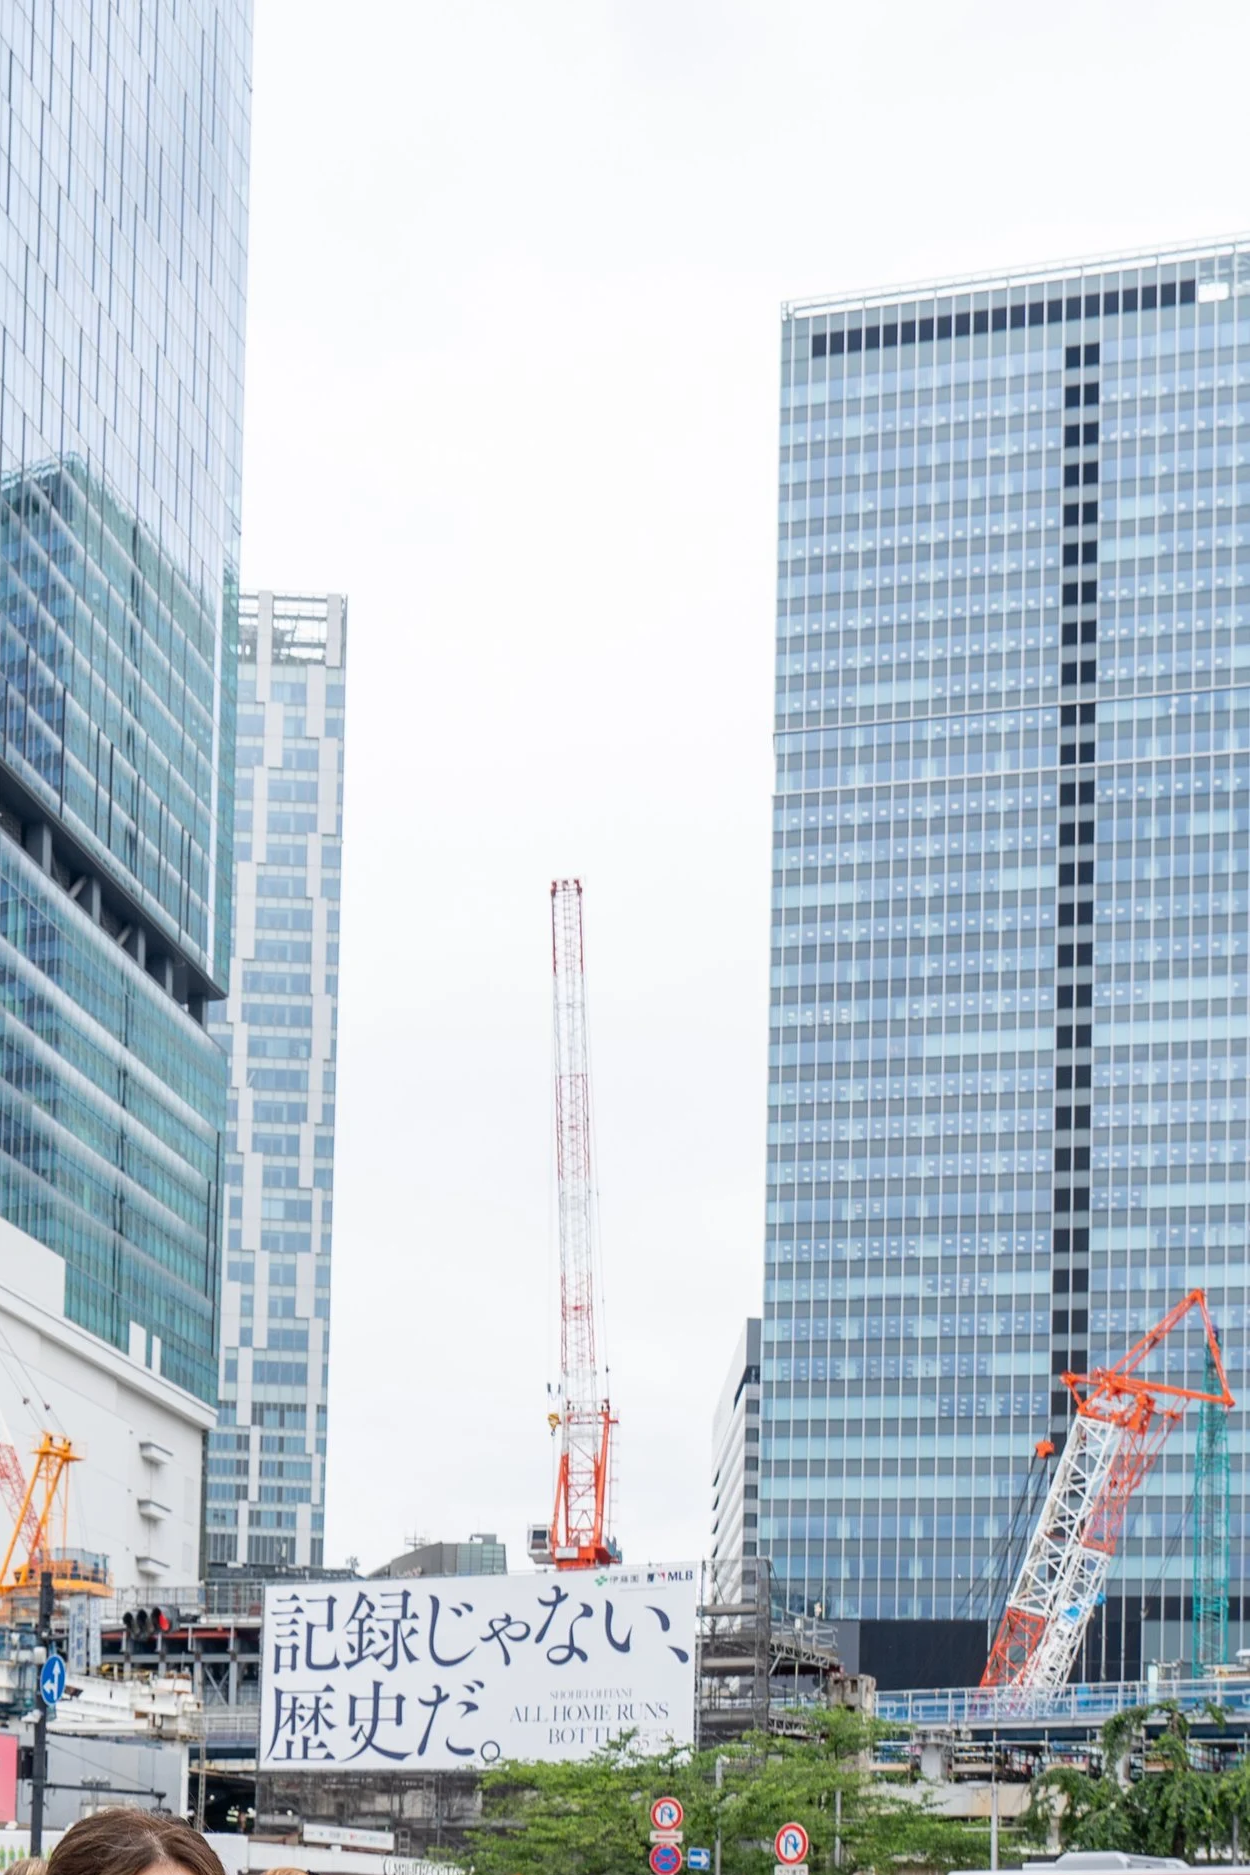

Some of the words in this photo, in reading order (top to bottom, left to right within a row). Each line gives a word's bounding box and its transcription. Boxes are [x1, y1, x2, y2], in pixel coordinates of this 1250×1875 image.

[667, 1569, 693, 1582] MLB
[271, 1585, 689, 1674] 記録じゃない、
[264, 1680, 501, 1762] 歴史だ。
[510, 1704, 548, 1723] ALL
[553, 1703, 611, 1722] HOME
[617, 1701, 669, 1720] RUNS
